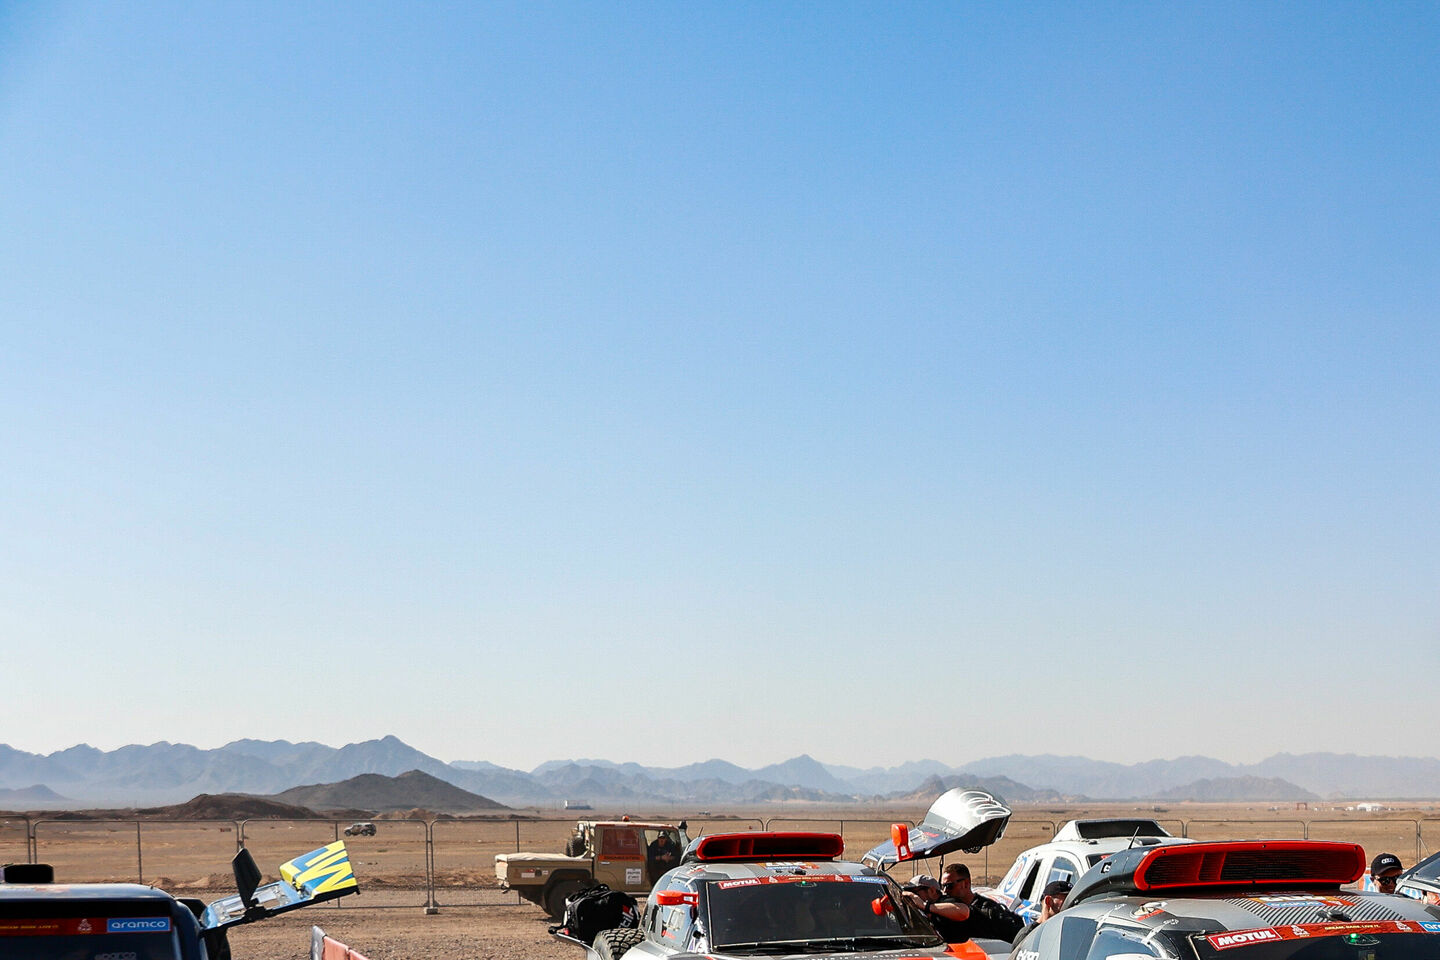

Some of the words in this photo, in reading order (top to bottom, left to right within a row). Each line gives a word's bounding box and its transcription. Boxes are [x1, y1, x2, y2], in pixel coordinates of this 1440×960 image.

[722, 878, 760, 888] MOTUL
[111, 919, 167, 930] aramco
[1216, 930, 1277, 946] MOTUL
